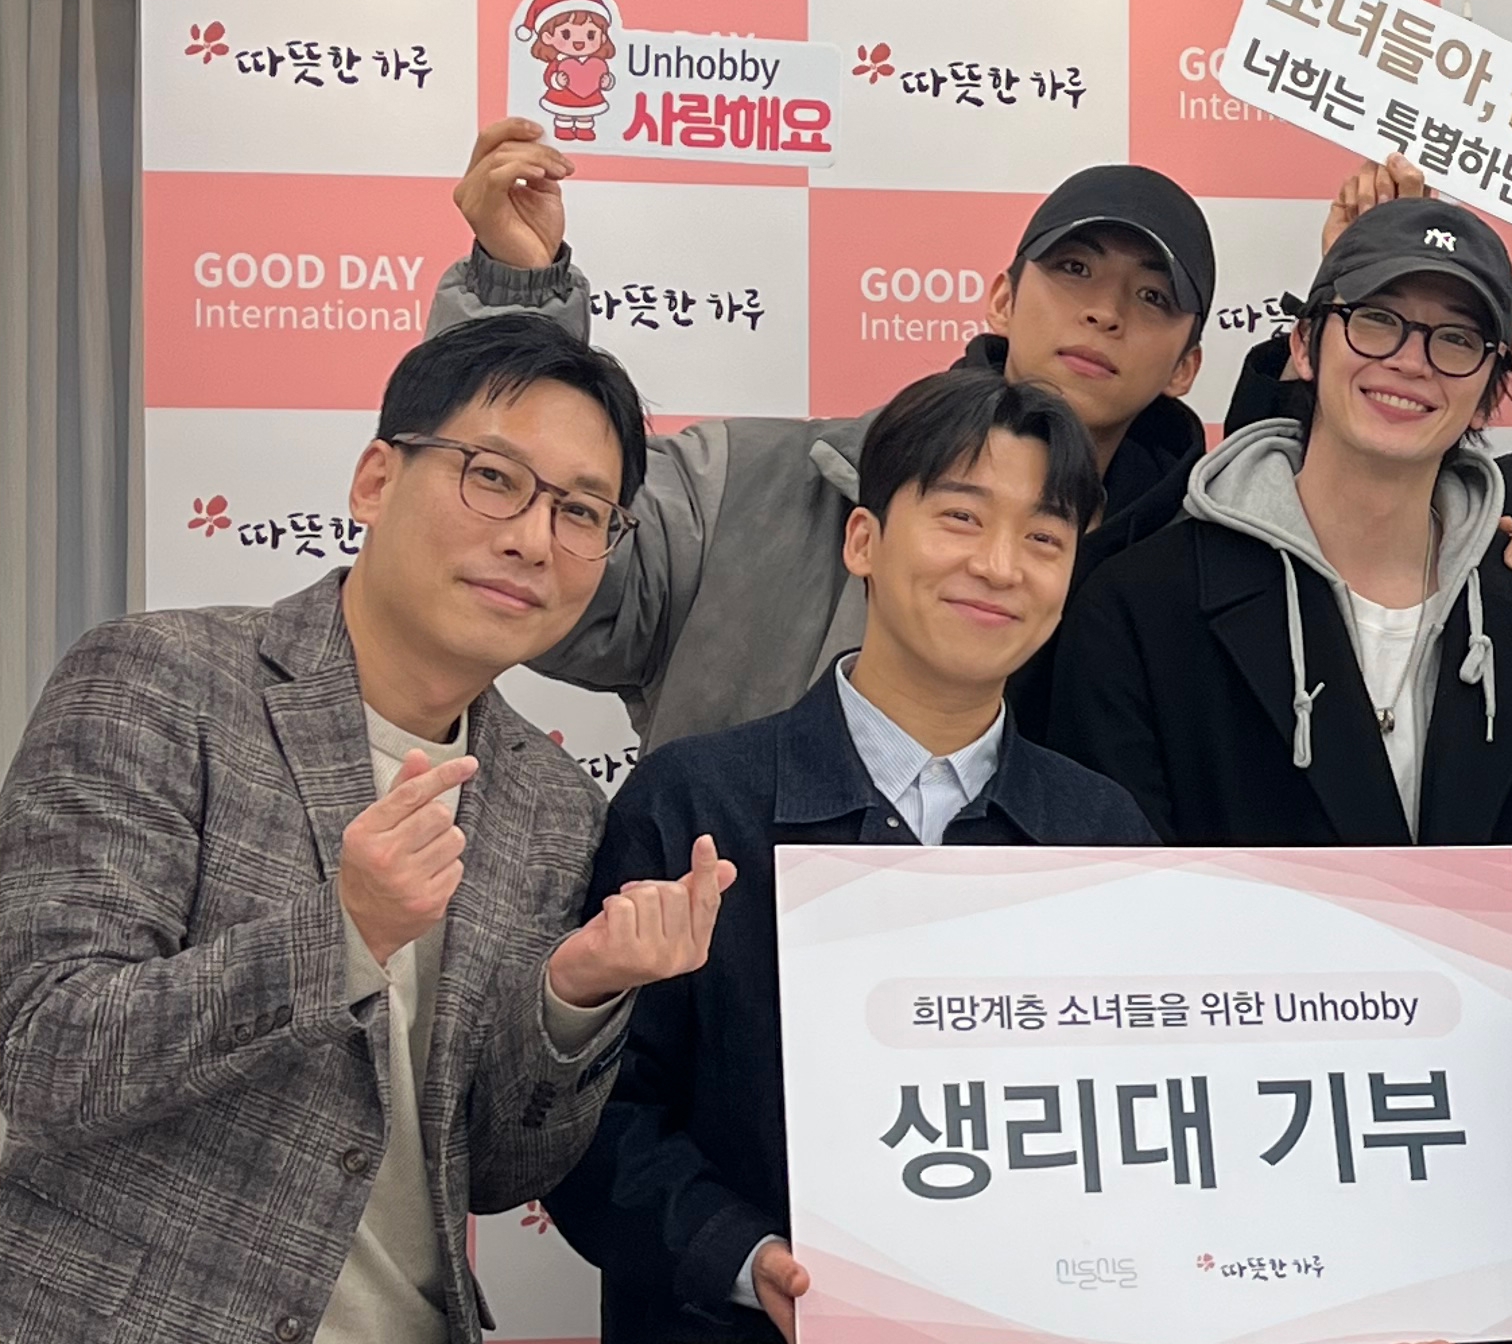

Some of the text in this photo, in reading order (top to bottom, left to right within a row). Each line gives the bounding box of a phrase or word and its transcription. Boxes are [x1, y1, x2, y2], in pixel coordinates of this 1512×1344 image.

[235, 41, 433, 88] 따뜻한 하루
[627, 44, 779, 88] Unhobby
[900, 61, 1087, 108] 따뜻한 하루
[1243, 38, 1366, 131] 너희는
[623, 92, 831, 152] 사랑해요
[194, 252, 424, 291] GOOD DAY
[861, 267, 984, 303] GOOD
[194, 298, 423, 333] International
[707, 288, 765, 331] 하루
[912, 990, 1419, 1031] 희망계층 소녀들을 위한 Unhobby
[879, 1070, 1468, 1199] 생리대 기부
[1220, 1255, 1325, 1282] 따뜻한 하루
